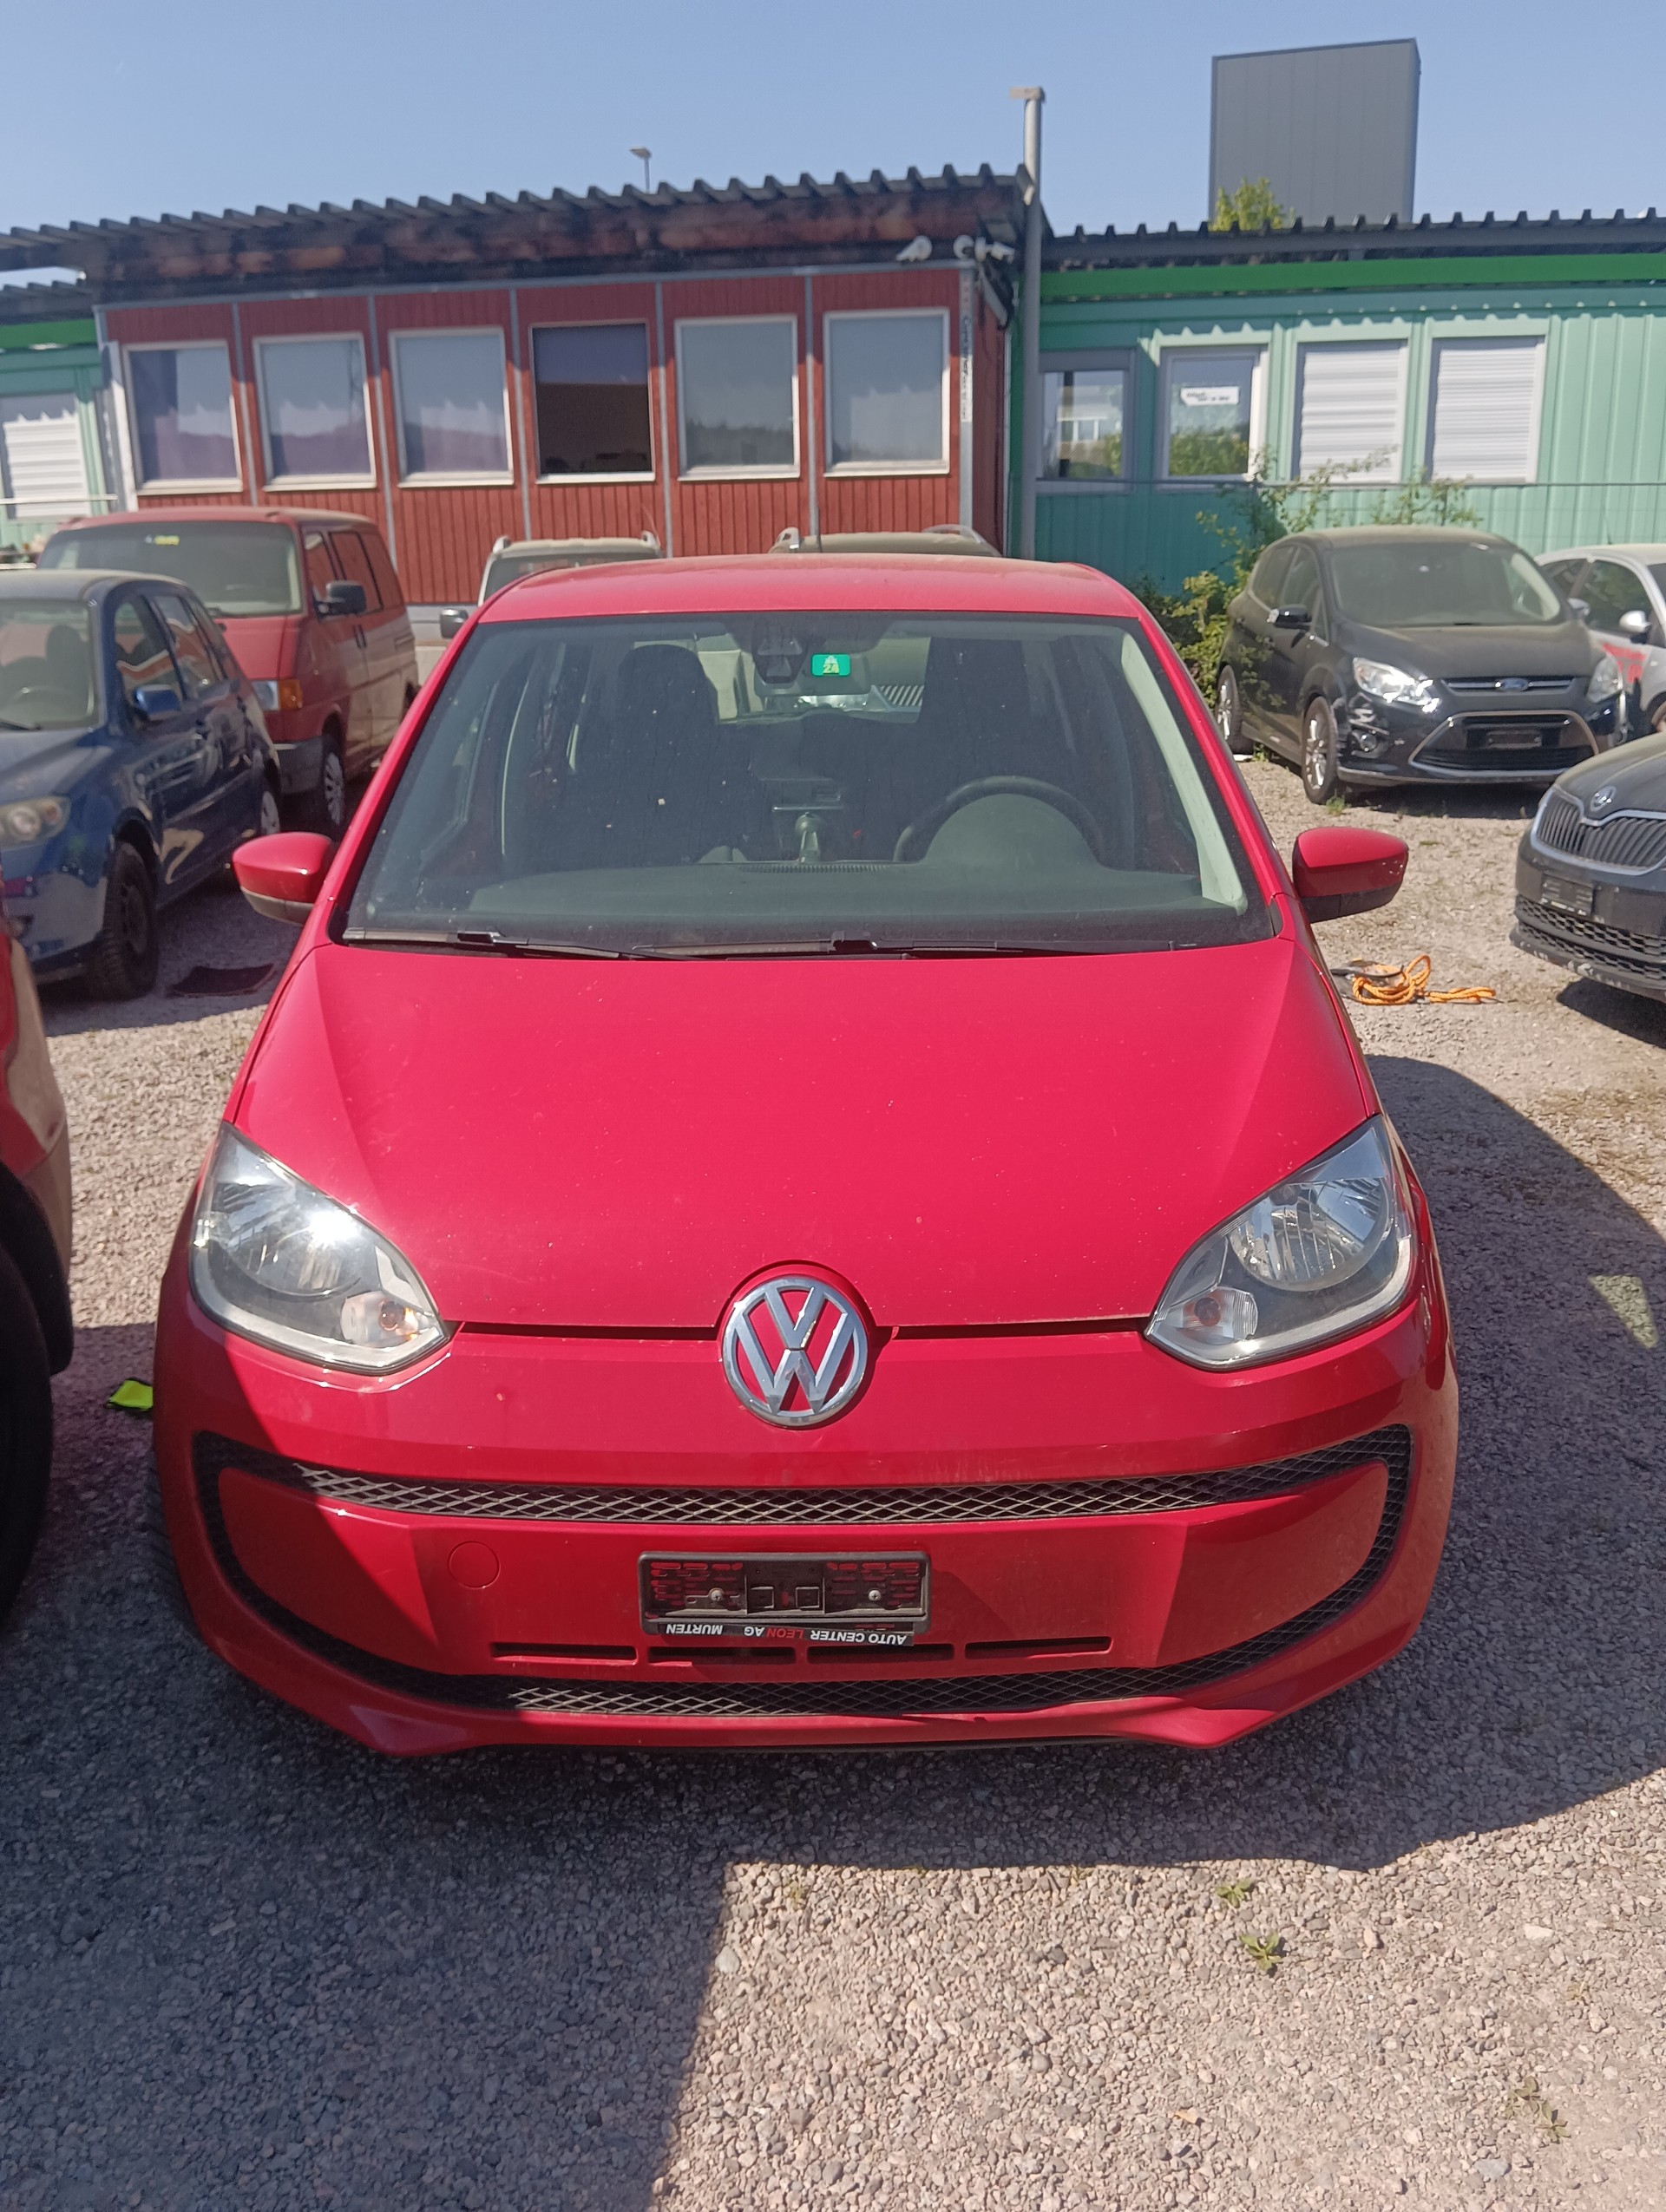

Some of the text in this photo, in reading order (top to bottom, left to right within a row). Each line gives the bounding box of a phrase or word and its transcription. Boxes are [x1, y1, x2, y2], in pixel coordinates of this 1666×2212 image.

[666, 1623, 907, 1646] AUTO CENTER LEON AG MURTEN
